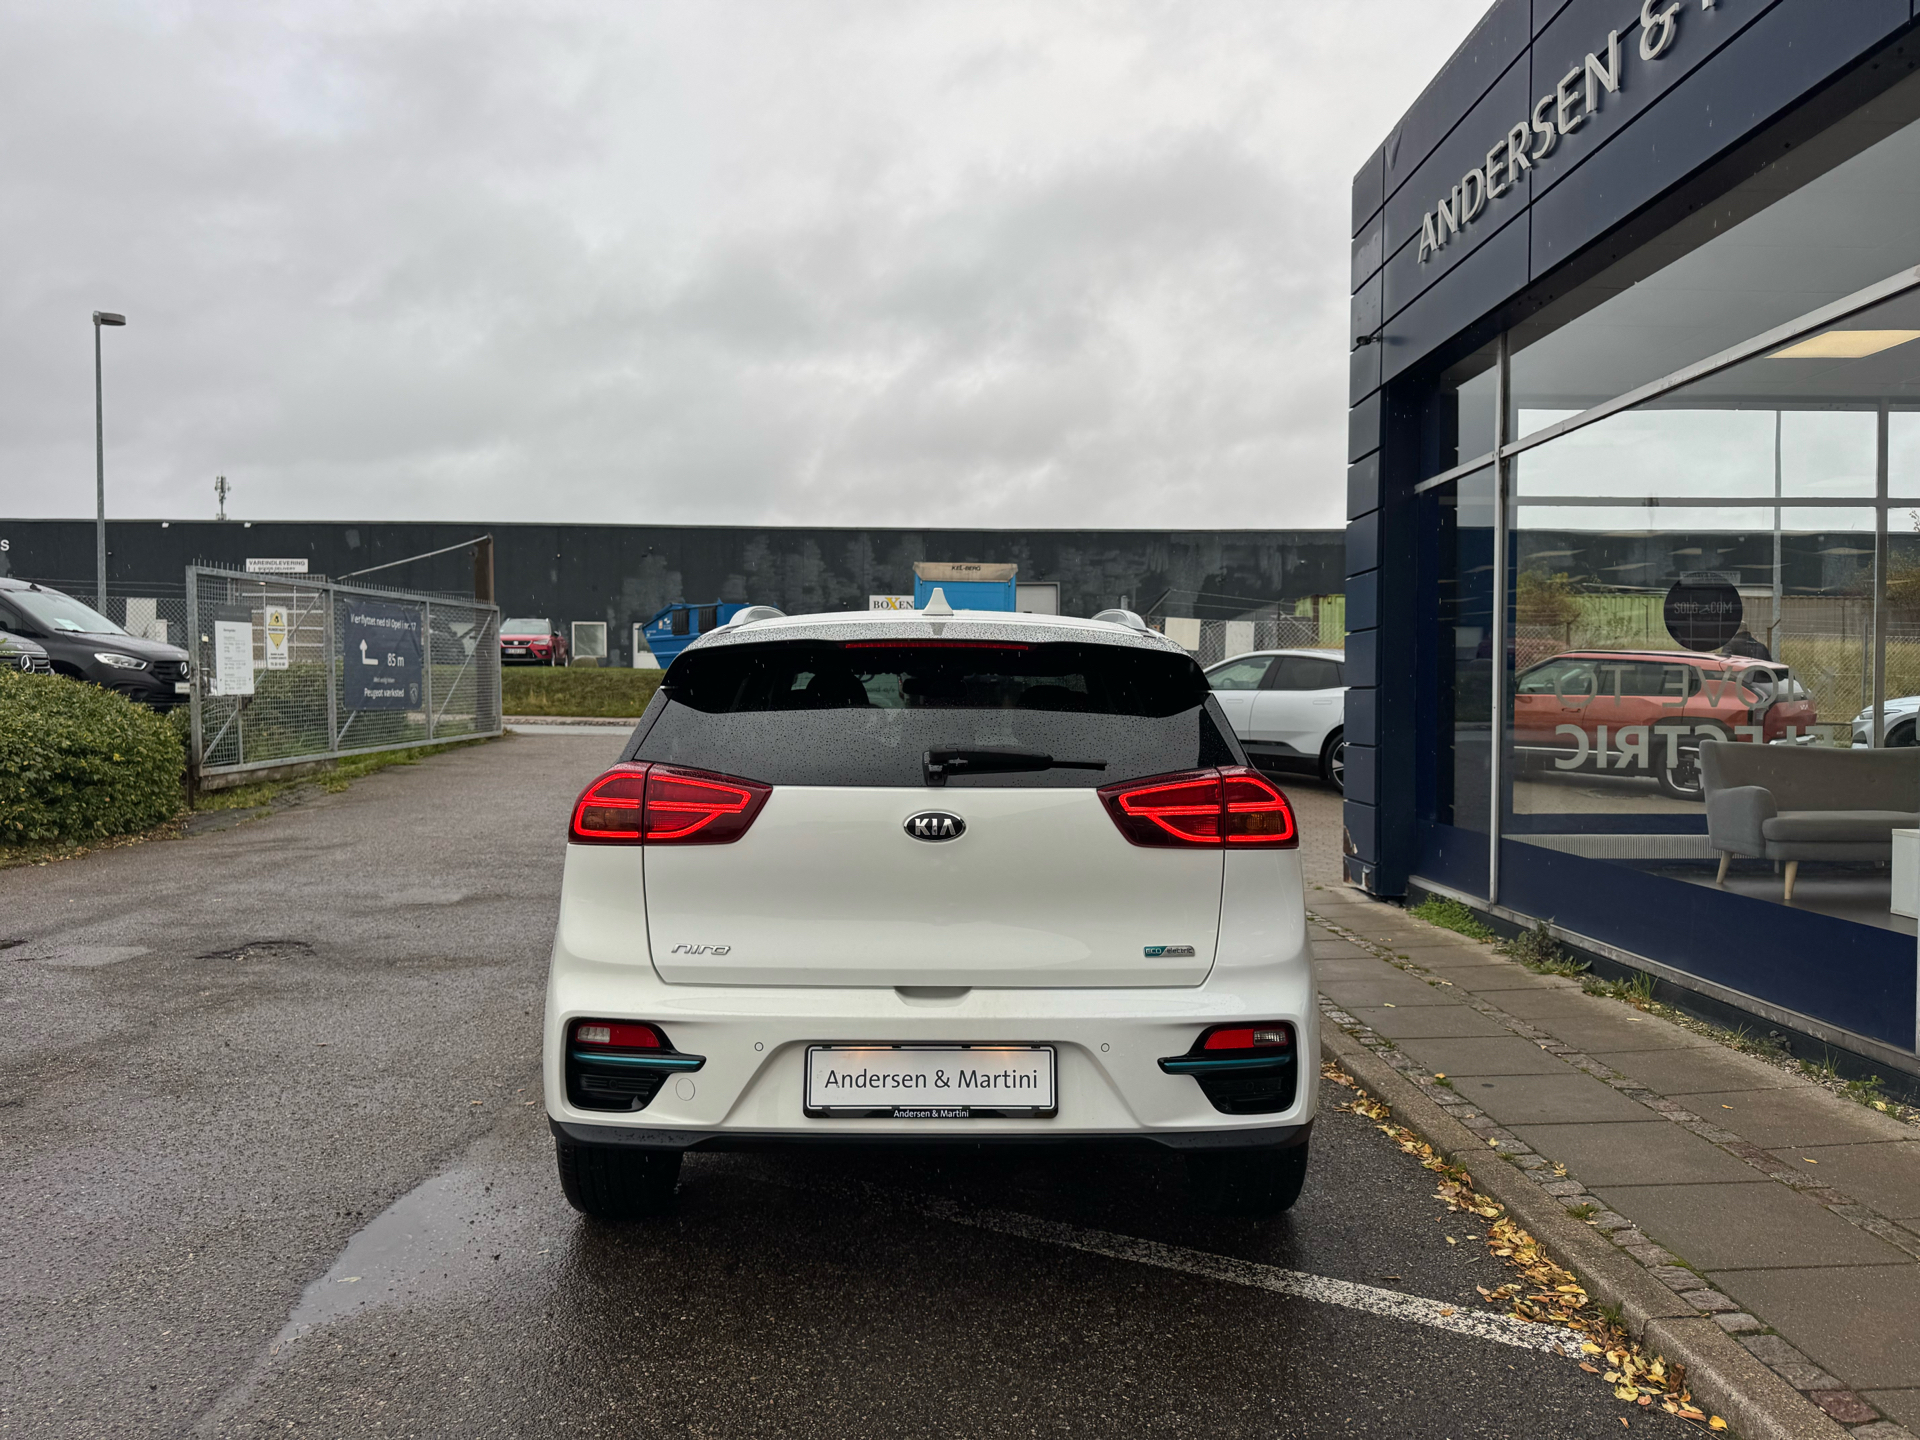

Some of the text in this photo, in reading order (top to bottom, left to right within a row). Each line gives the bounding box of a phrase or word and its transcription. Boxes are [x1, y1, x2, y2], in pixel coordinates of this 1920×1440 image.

[1417, 0, 1681, 264] ANDERSEN &
[873, 597, 914, 610] BOXEN
[391, 619, 402, 631] Opel
[387, 652, 405, 667] 85 m
[364, 687, 383, 700] Peugeot
[914, 818, 956, 836] KIA
[824, 1068, 1038, 1089] Andersen & Martini
[893, 1109, 970, 1118] Andersen & Martini
